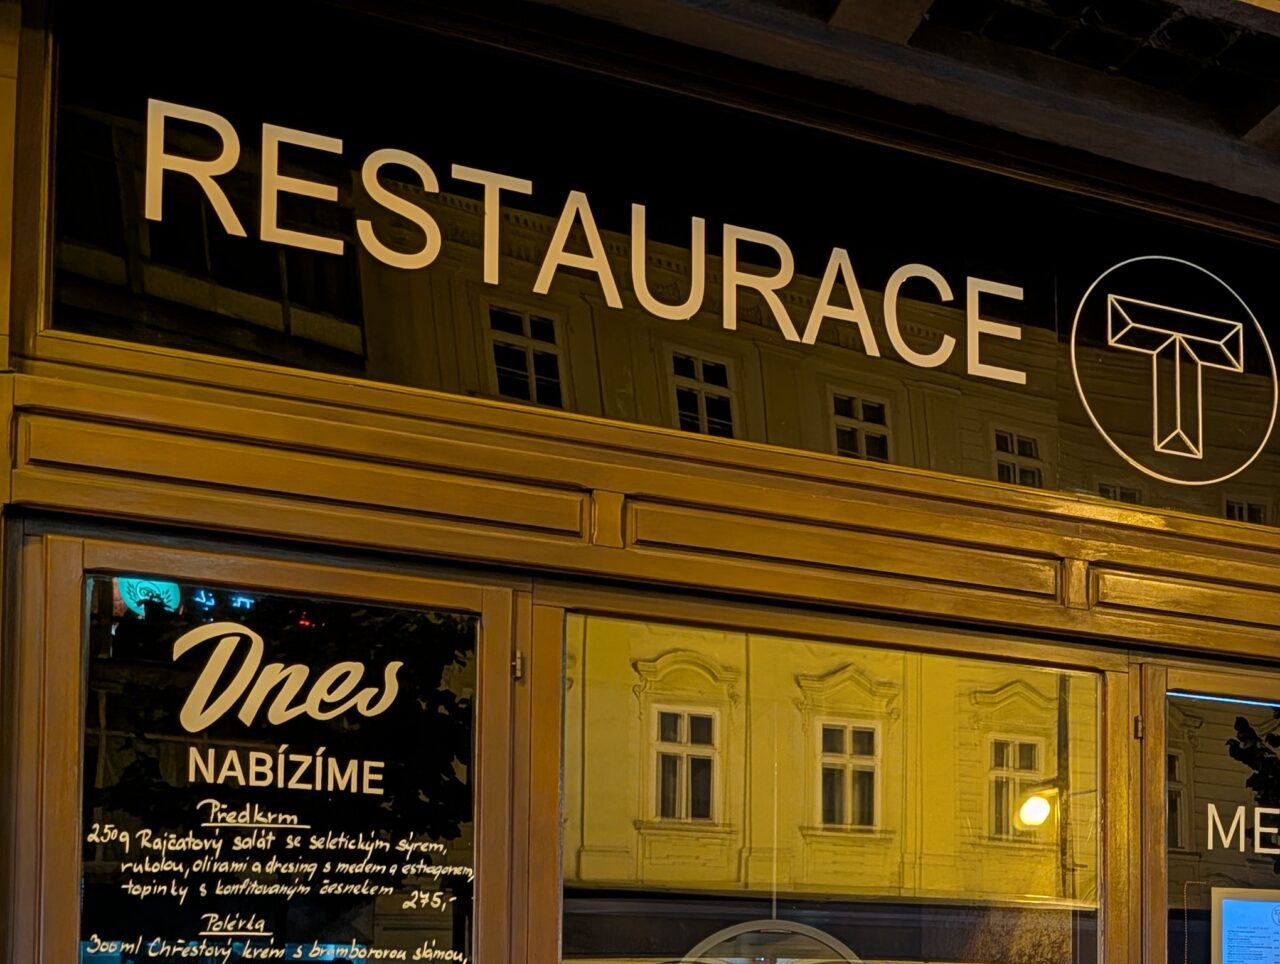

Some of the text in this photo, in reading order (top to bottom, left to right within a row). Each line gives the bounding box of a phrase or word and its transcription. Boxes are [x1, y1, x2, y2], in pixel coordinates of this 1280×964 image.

[145, 97, 1028, 385] RESTAURACE
[173, 622, 403, 733] Dnes
[188, 744, 385, 795] NABÍZÍME
[197, 799, 298, 825] Předkrm
[87, 823, 130, 853] 250g
[135, 828, 223, 860] Rajčatový
[232, 829, 276, 850] salát
[286, 836, 301, 850] se
[395, 831, 447, 861] sýrem,
[251, 861, 262, 874] a
[323, 861, 331, 874] s
[336, 859, 386, 874] medem
[389, 864, 398, 876] a
[121, 880, 189, 905] topinky
[199, 882, 207, 896] s
[319, 879, 394, 896] česnekem
[201, 913, 266, 932] Polévka
[147, 937, 232, 964] Chřestový
[242, 938, 286, 959] krém
[293, 945, 302, 958] s
